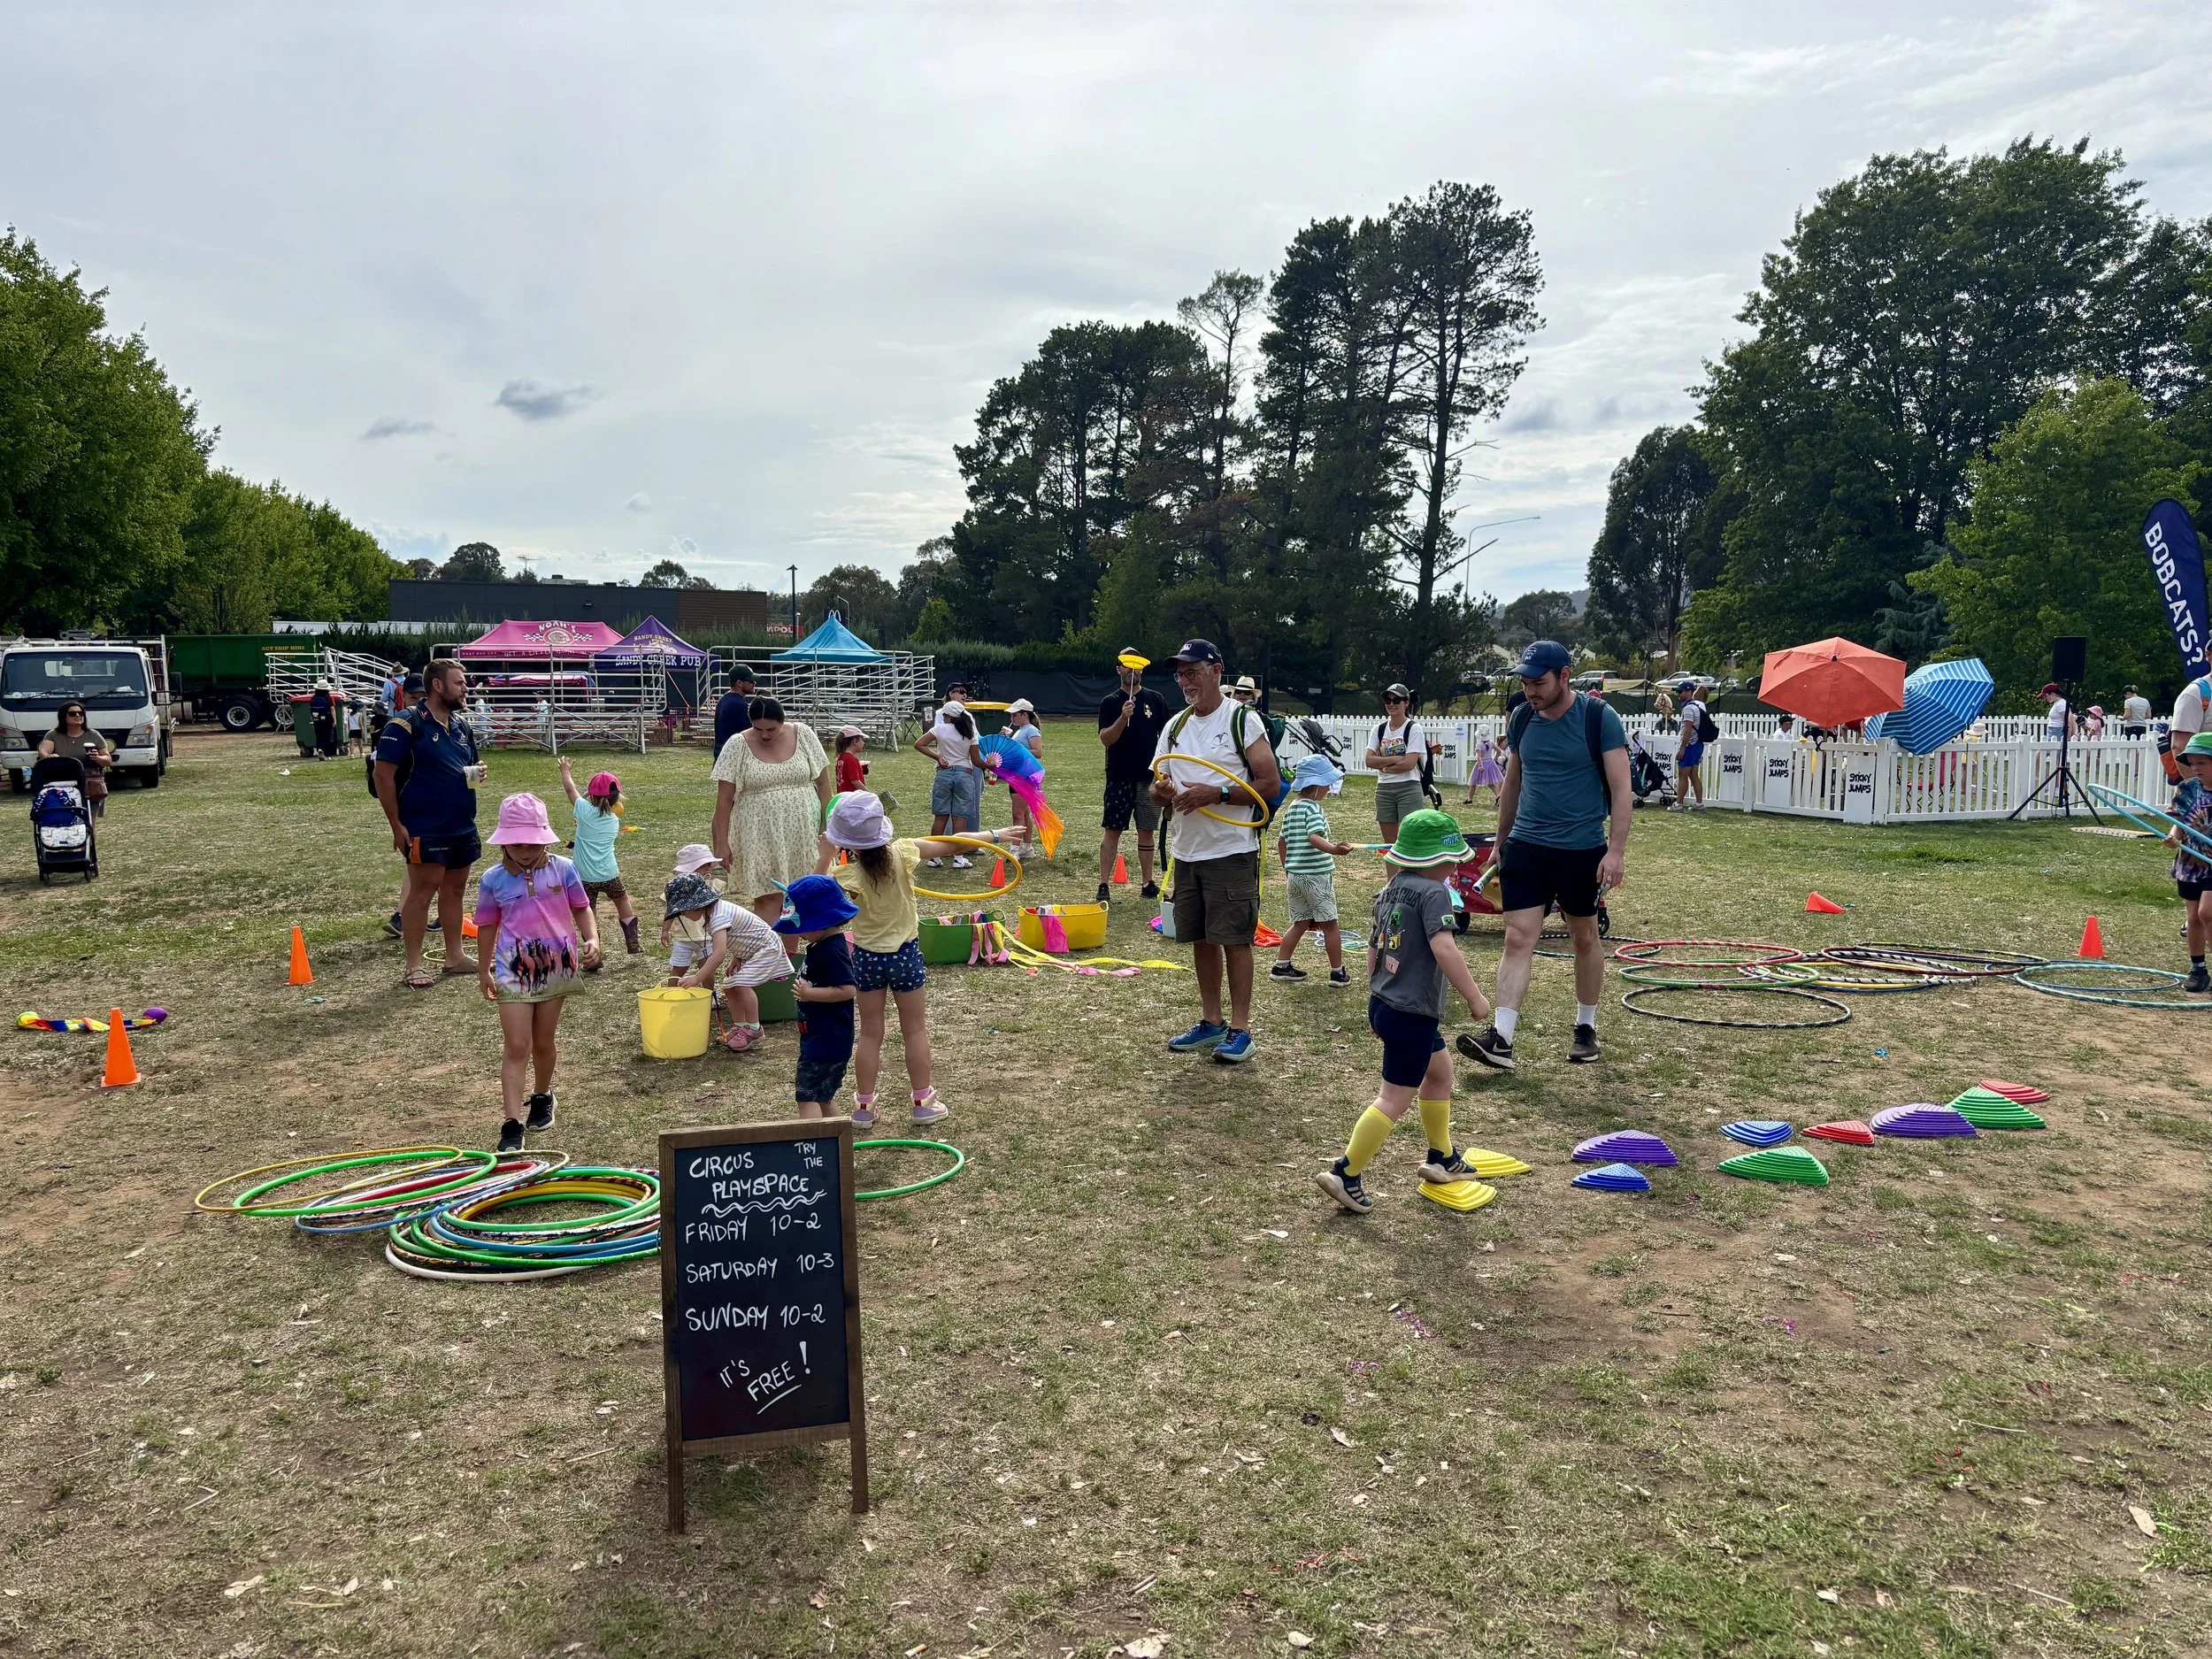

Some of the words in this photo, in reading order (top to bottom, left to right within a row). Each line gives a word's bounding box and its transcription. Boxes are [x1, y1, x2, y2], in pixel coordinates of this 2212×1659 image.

[2145, 521, 2203, 665] BOBCATS?
[538, 621, 576, 634] NOAH'S
[615, 655, 644, 666] SANDY
[680, 656, 702, 666] PUB
[1723, 764, 1743, 773] JUMPS
[1769, 769, 1789, 778] JUMPS
[1848, 784, 1871, 794] JUMPS
[795, 1142, 817, 1154] TRY
[689, 1152, 754, 1178] CIRCUS
[803, 1156, 823, 1170] THE
[712, 1173, 810, 1202] PLAYSPACE
[686, 1216, 748, 1244] FRIDAY
[771, 1212, 822, 1236] 10-2
[686, 1256, 778, 1283] SATURDAY
[796, 1253, 834, 1274] 10-3
[686, 1303, 769, 1331] SUNDAY
[780, 1304, 826, 1327] 10-2
[719, 1360, 749, 1388] IT'S
